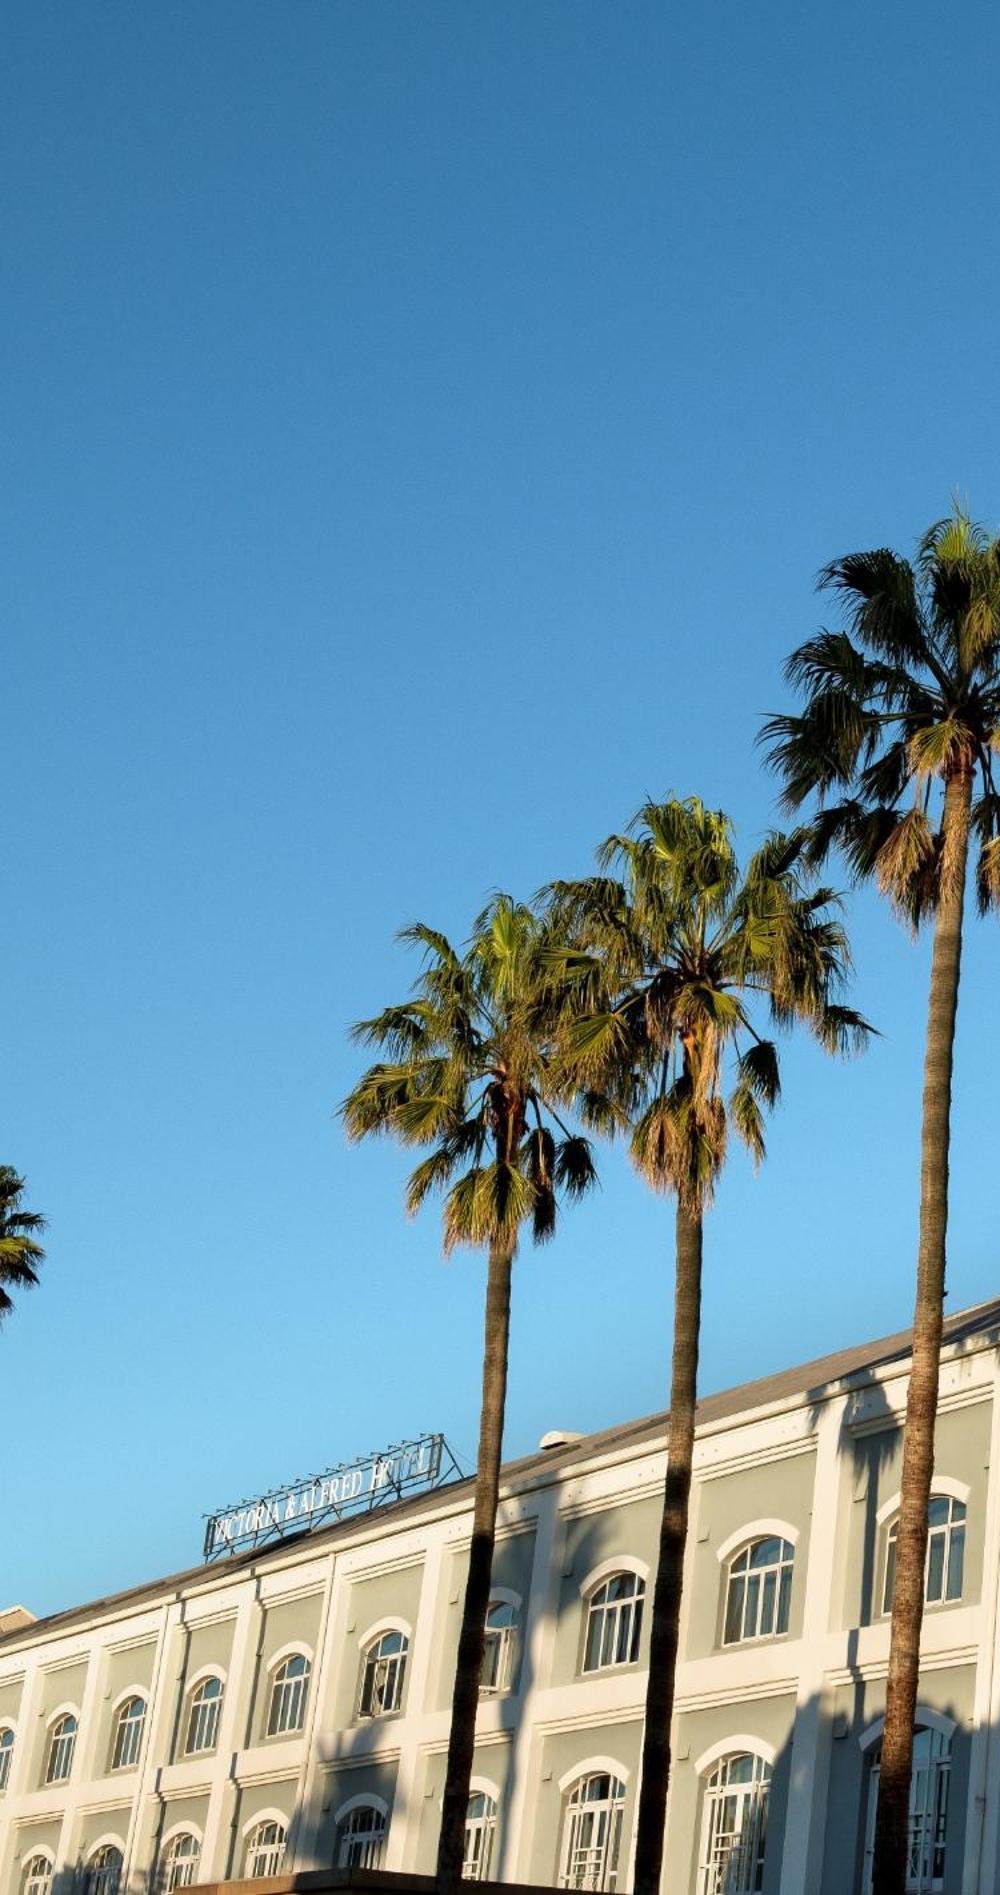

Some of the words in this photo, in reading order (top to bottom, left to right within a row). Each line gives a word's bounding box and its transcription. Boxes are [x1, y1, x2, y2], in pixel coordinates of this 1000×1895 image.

[212, 1501, 279, 1544] VICTORIA
[284, 1494, 299, 1521] &
[299, 1471, 362, 1513] ALFRED
